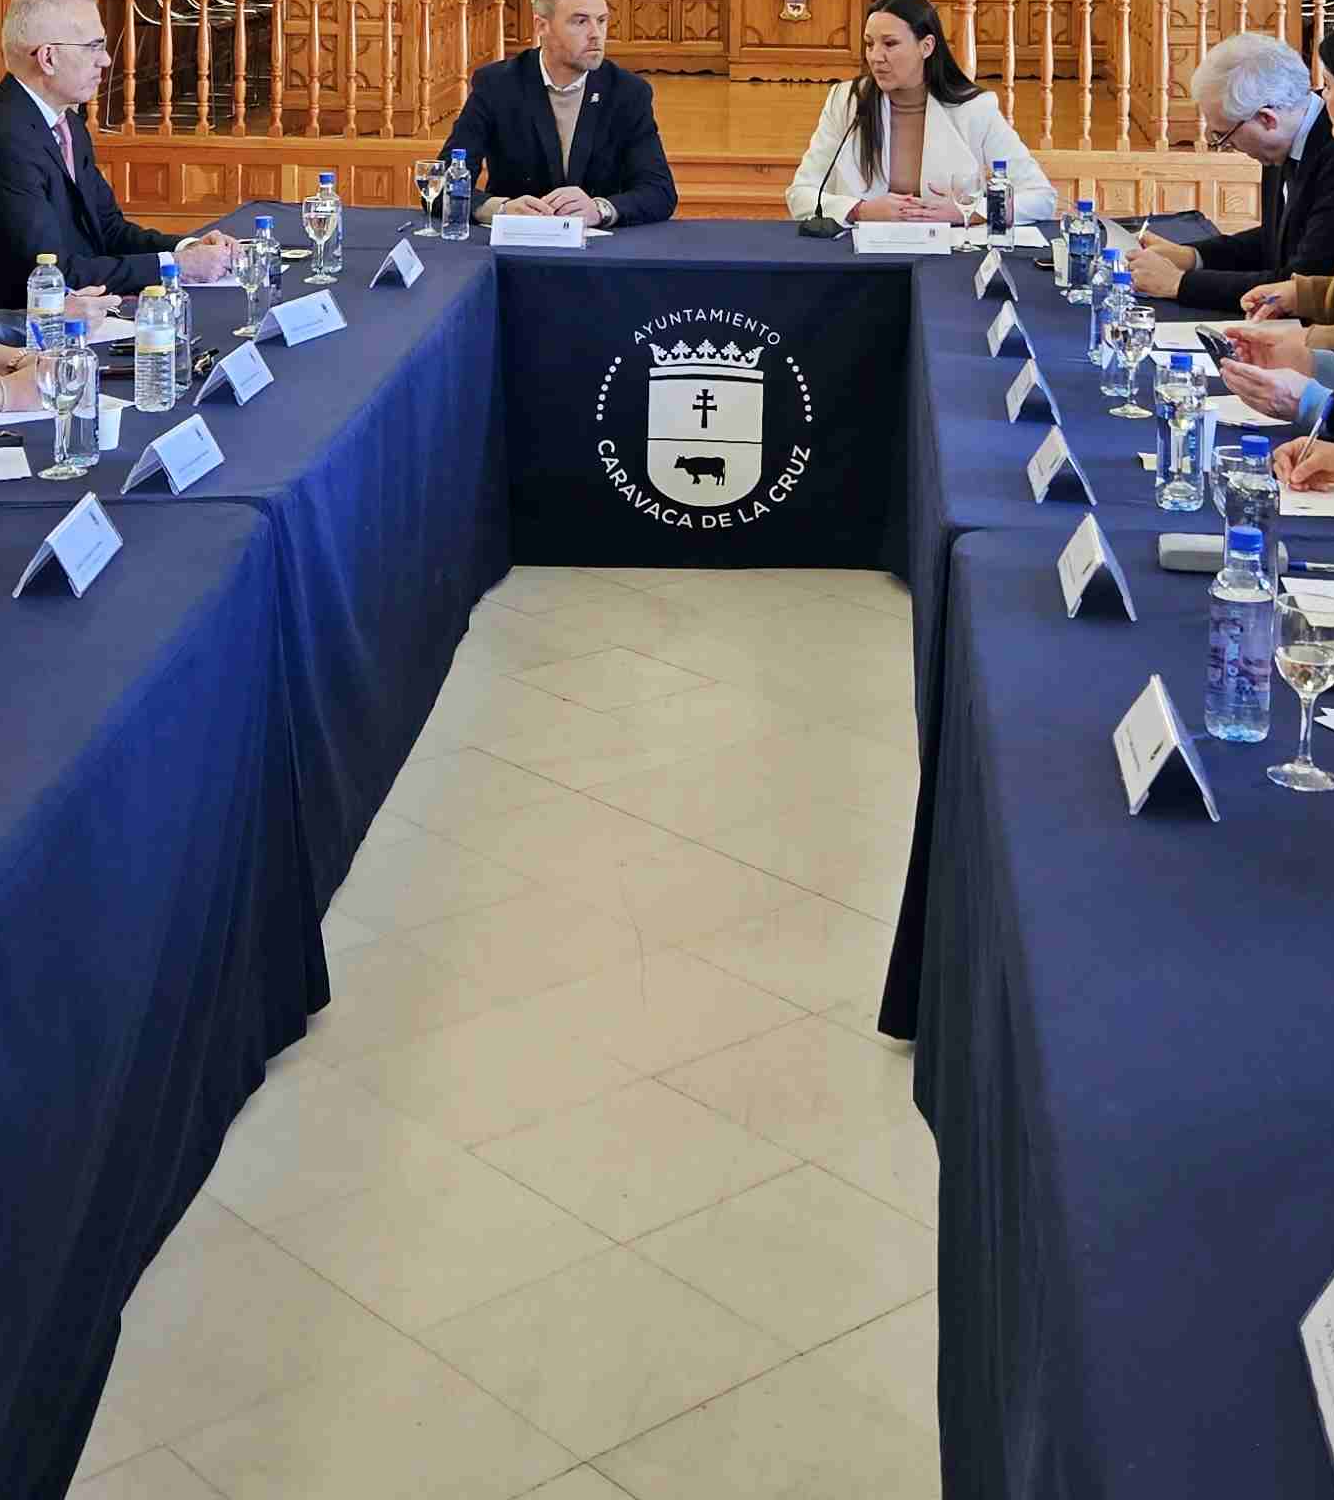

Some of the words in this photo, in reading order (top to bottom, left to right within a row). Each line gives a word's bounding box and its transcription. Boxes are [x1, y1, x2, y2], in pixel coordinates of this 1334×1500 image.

[633, 308, 781, 345] AYUNTAMIENTO
[597, 439, 694, 530] CARAVACA
[701, 512, 733, 529] DE
[737, 501, 770, 524] LA
[768, 445, 811, 503] CRUZ
